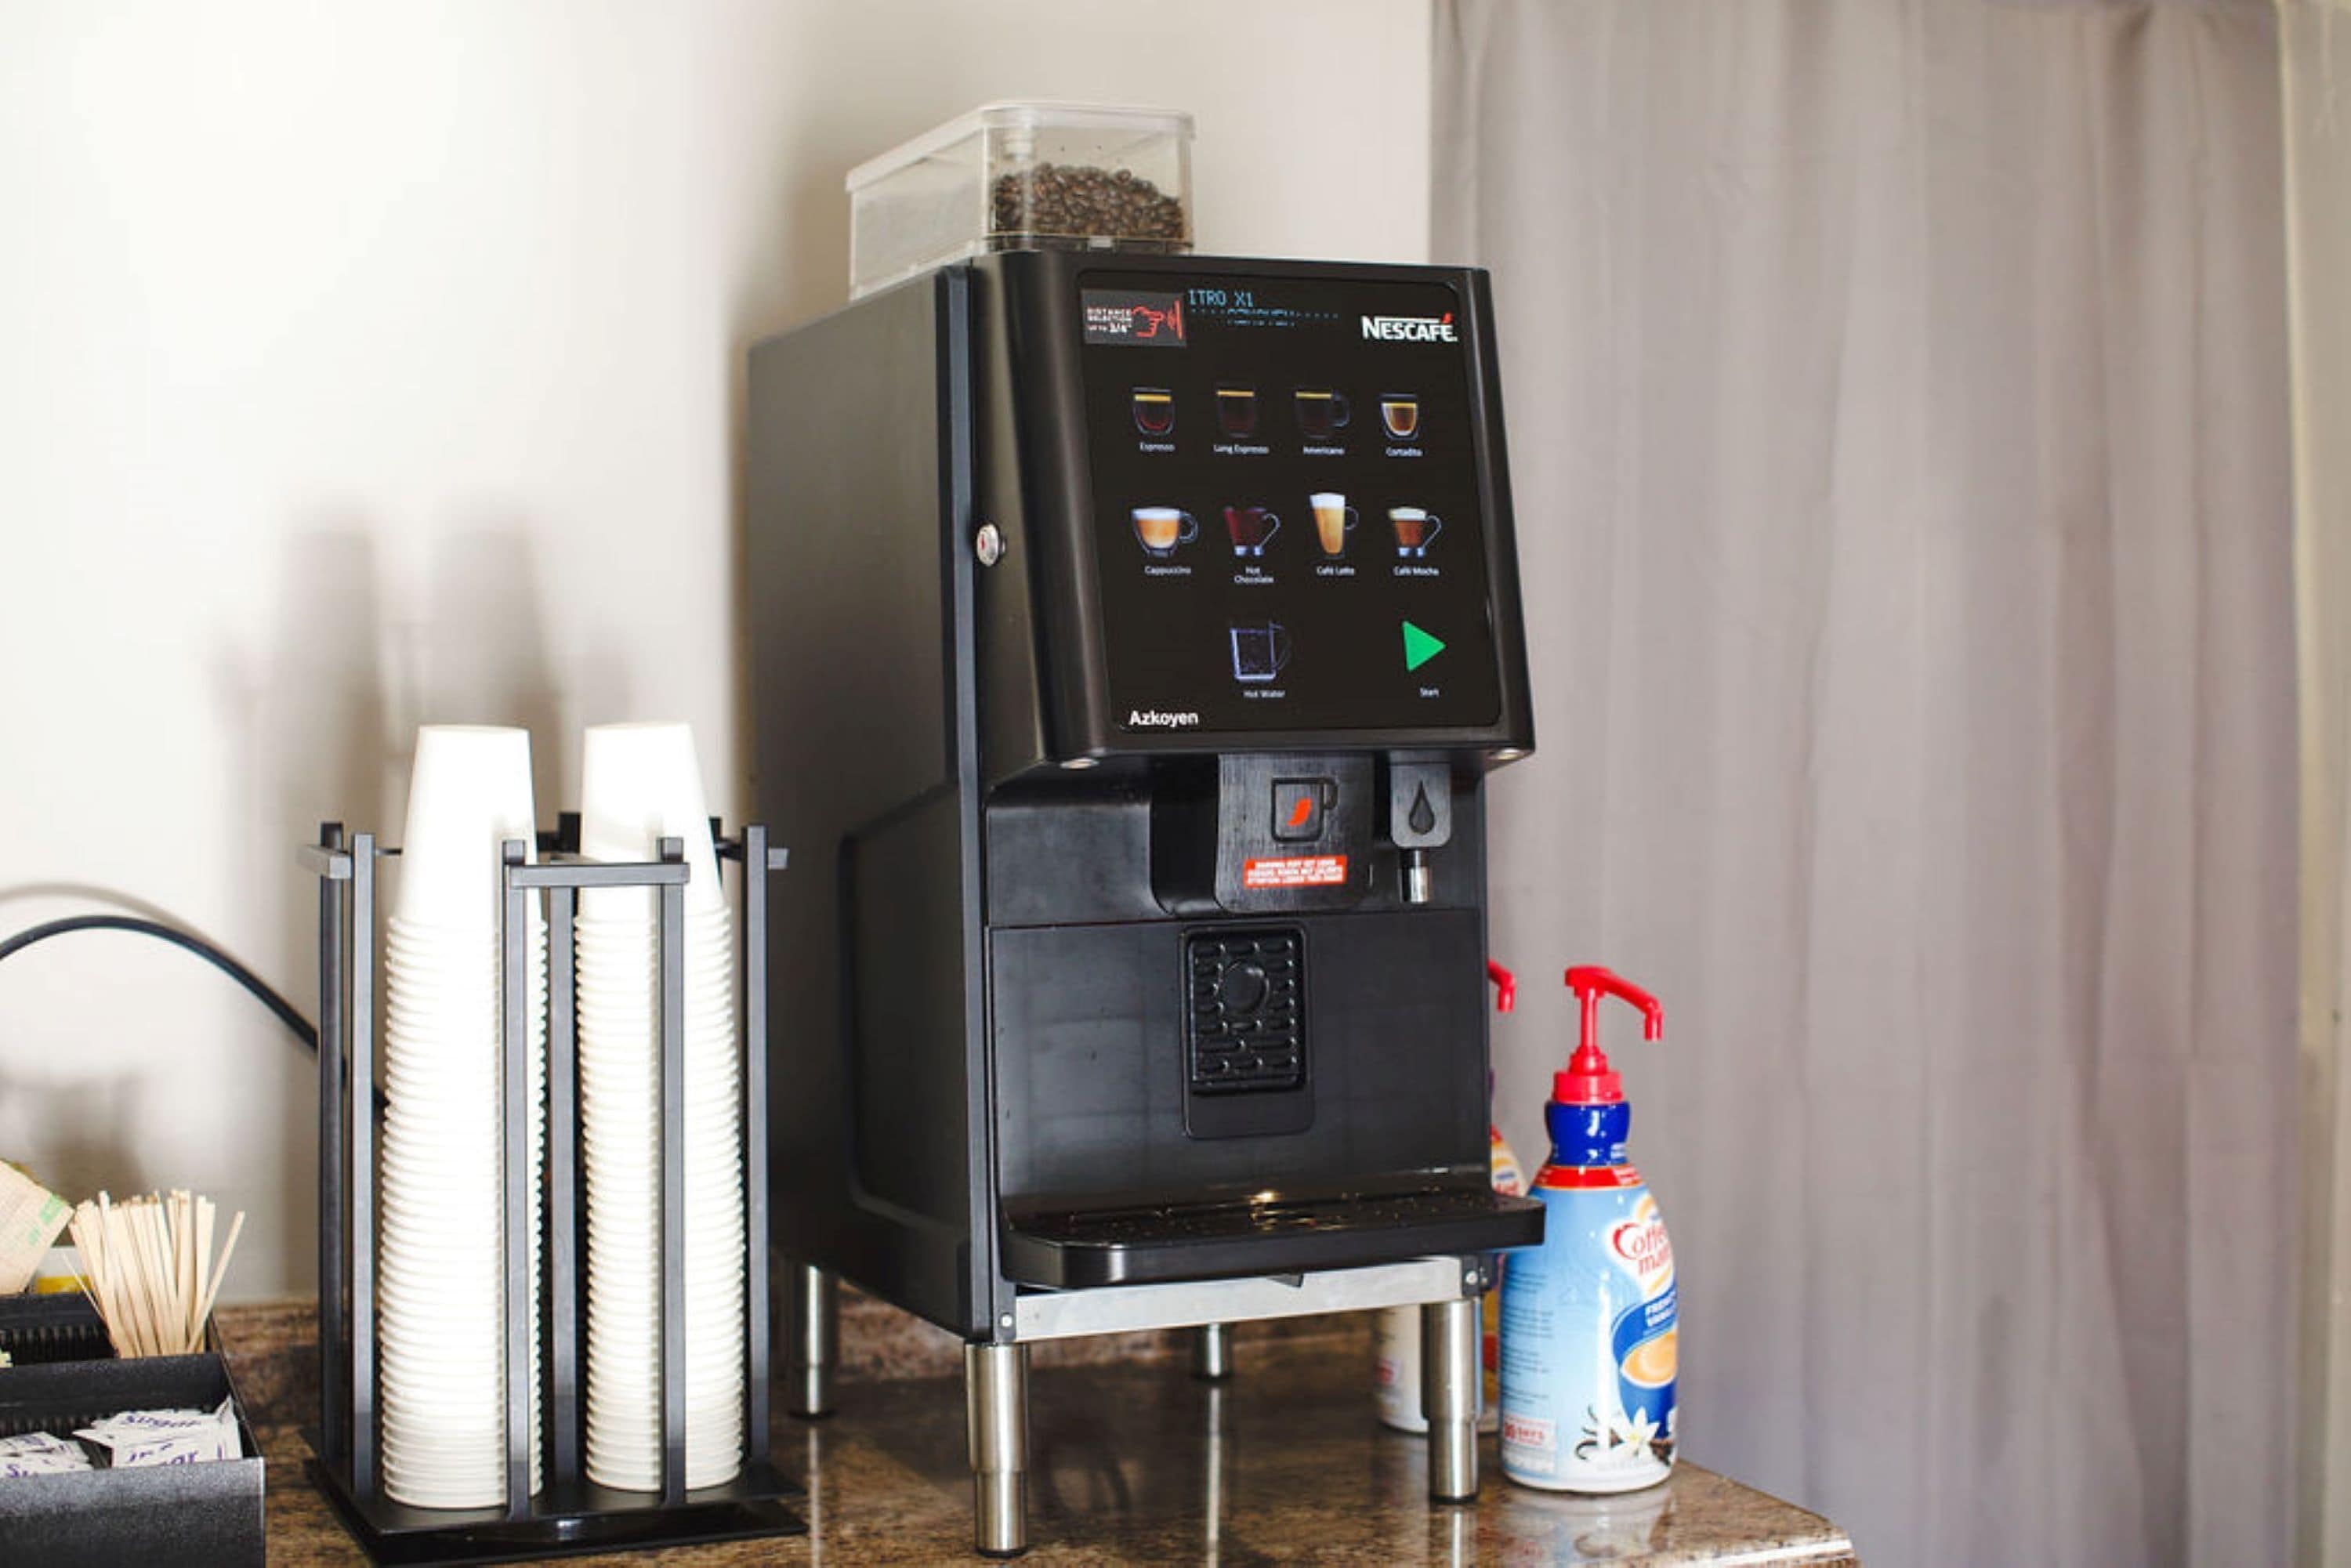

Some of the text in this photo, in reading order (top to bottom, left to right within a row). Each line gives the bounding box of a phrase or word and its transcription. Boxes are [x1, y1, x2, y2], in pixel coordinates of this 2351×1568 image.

[1235, 292, 1252, 307] X1
[1361, 312, 1458, 342] NESCAFÉ
[1145, 567, 1191, 575] Cappuccino
[1129, 710, 1198, 727] Azkoyen
